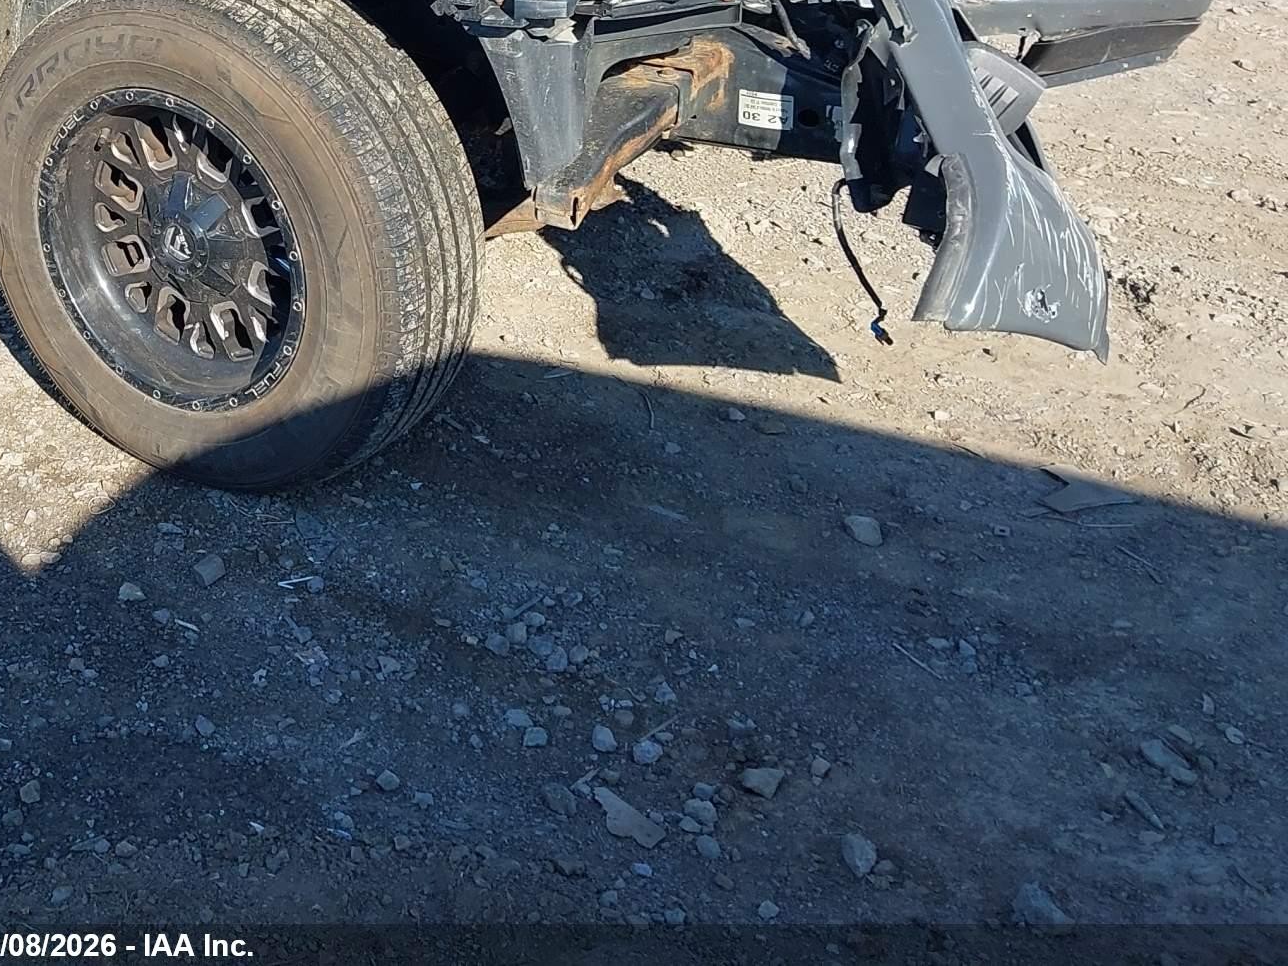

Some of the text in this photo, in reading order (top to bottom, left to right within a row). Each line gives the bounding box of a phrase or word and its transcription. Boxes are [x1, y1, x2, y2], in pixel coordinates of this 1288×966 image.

[4, 33, 163, 138] ARROYO
[50, 113, 85, 151] FUEL
[244, 361, 283, 399] FUEL
